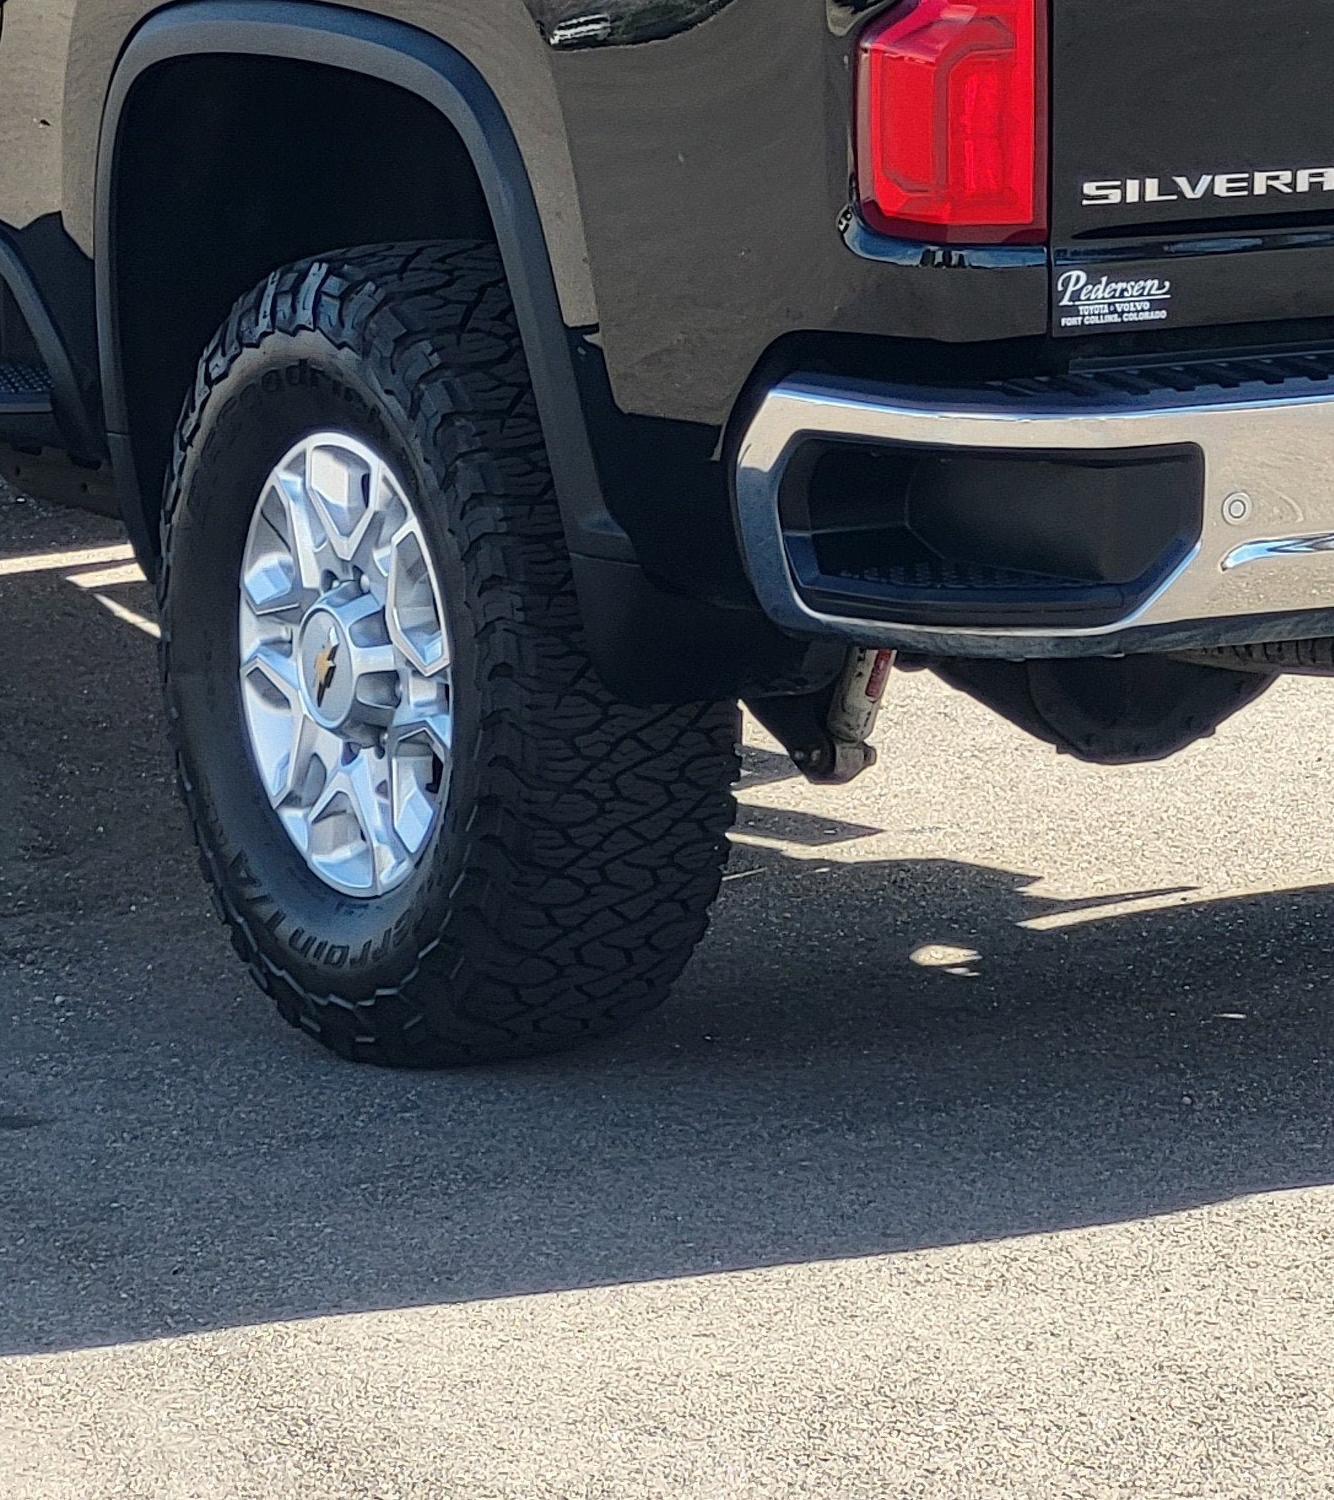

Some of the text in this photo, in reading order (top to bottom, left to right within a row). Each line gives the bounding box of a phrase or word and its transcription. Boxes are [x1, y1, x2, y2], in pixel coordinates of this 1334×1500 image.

[1057, 269, 1170, 306] Pedersen
[1078, 301, 1150, 315] TOYOTA VOLVO
